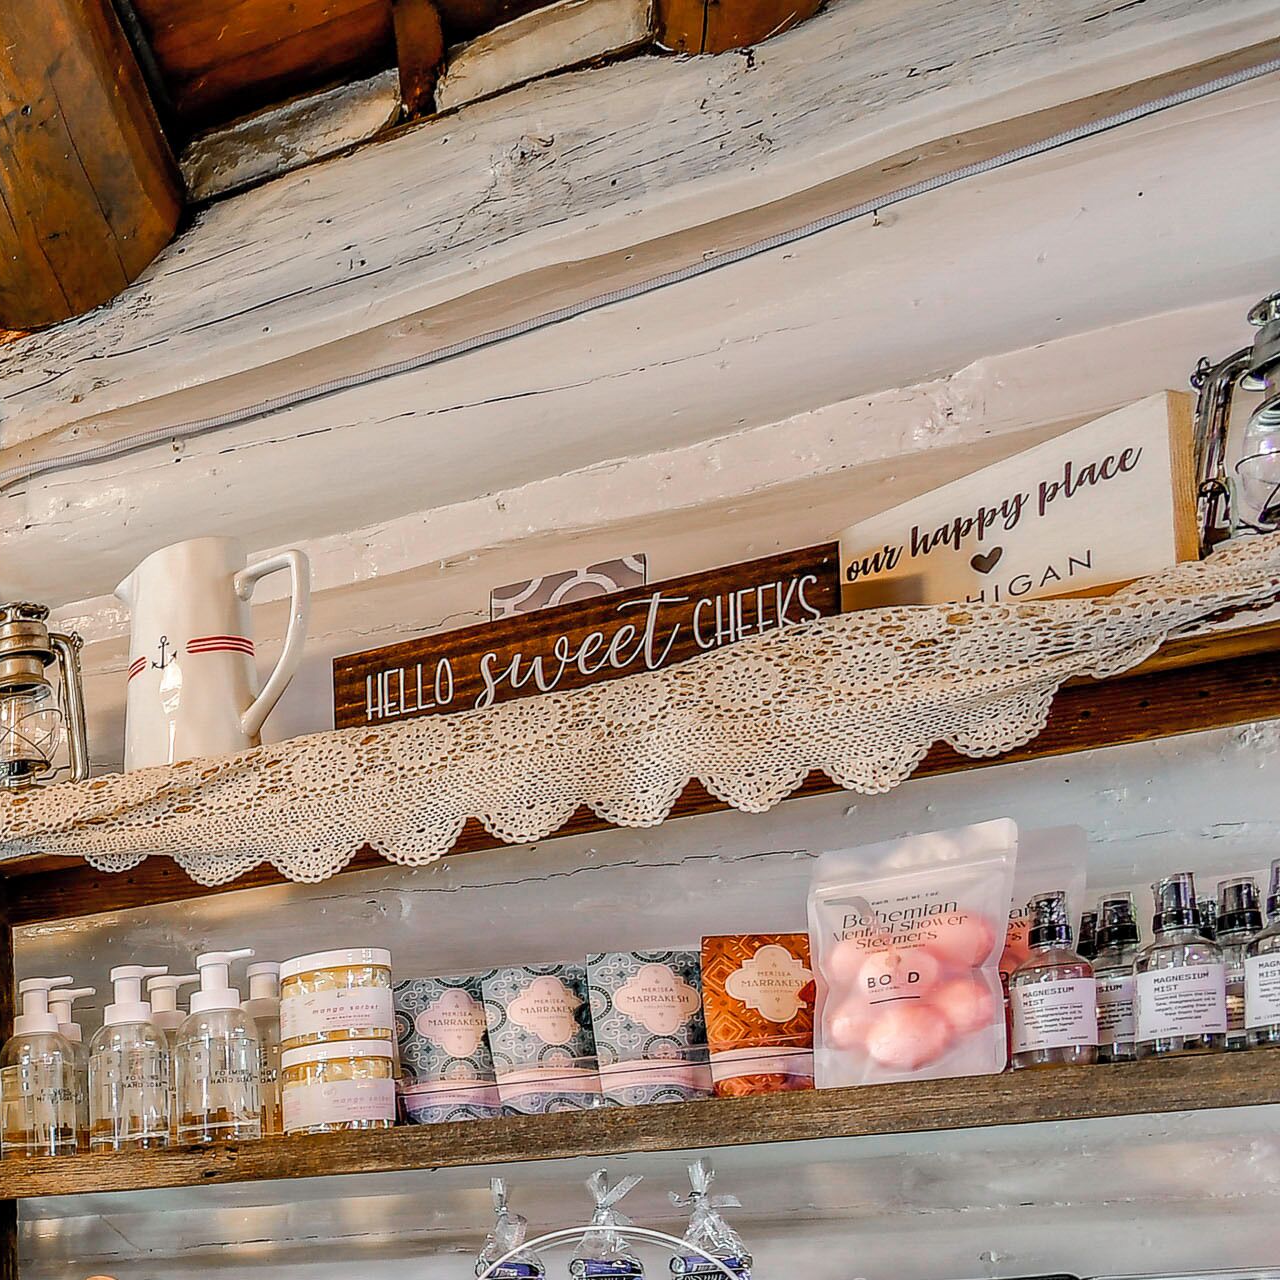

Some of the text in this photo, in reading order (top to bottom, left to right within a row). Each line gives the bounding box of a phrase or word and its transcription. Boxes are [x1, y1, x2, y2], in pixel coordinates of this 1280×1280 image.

[846, 447, 1143, 582] our happy place
[366, 575, 820, 720] HELLO sweet CHEEKS
[842, 901, 958, 929] Bohemian
[900, 915, 968, 935] Shower
[855, 930, 938, 950] Steamers
